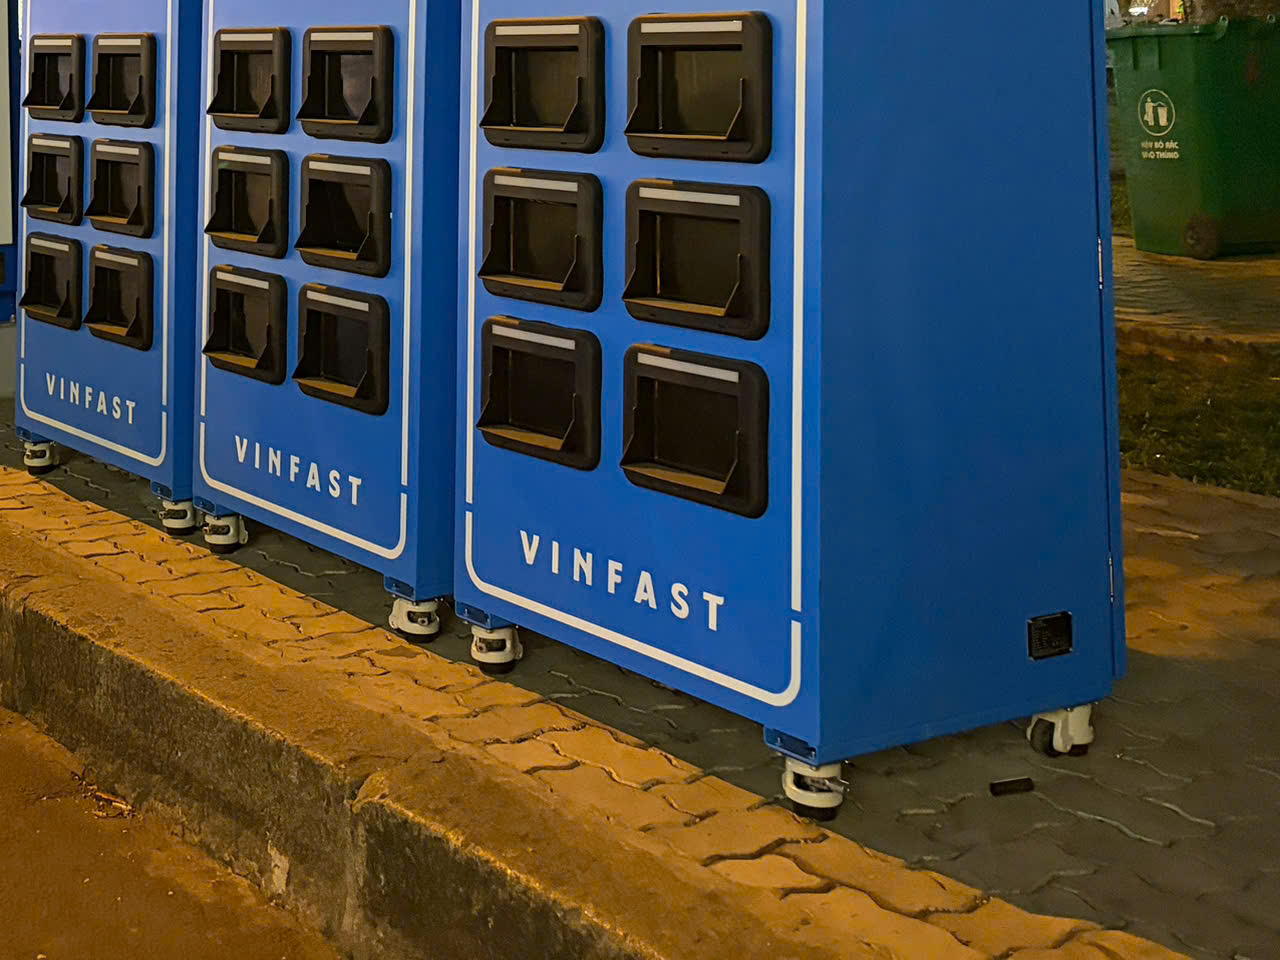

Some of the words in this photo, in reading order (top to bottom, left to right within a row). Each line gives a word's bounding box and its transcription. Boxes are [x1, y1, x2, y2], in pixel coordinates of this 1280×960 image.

[46, 372, 136, 424] VINFAST
[235, 435, 362, 505] VINFAST
[520, 530, 724, 631] VINFAST
